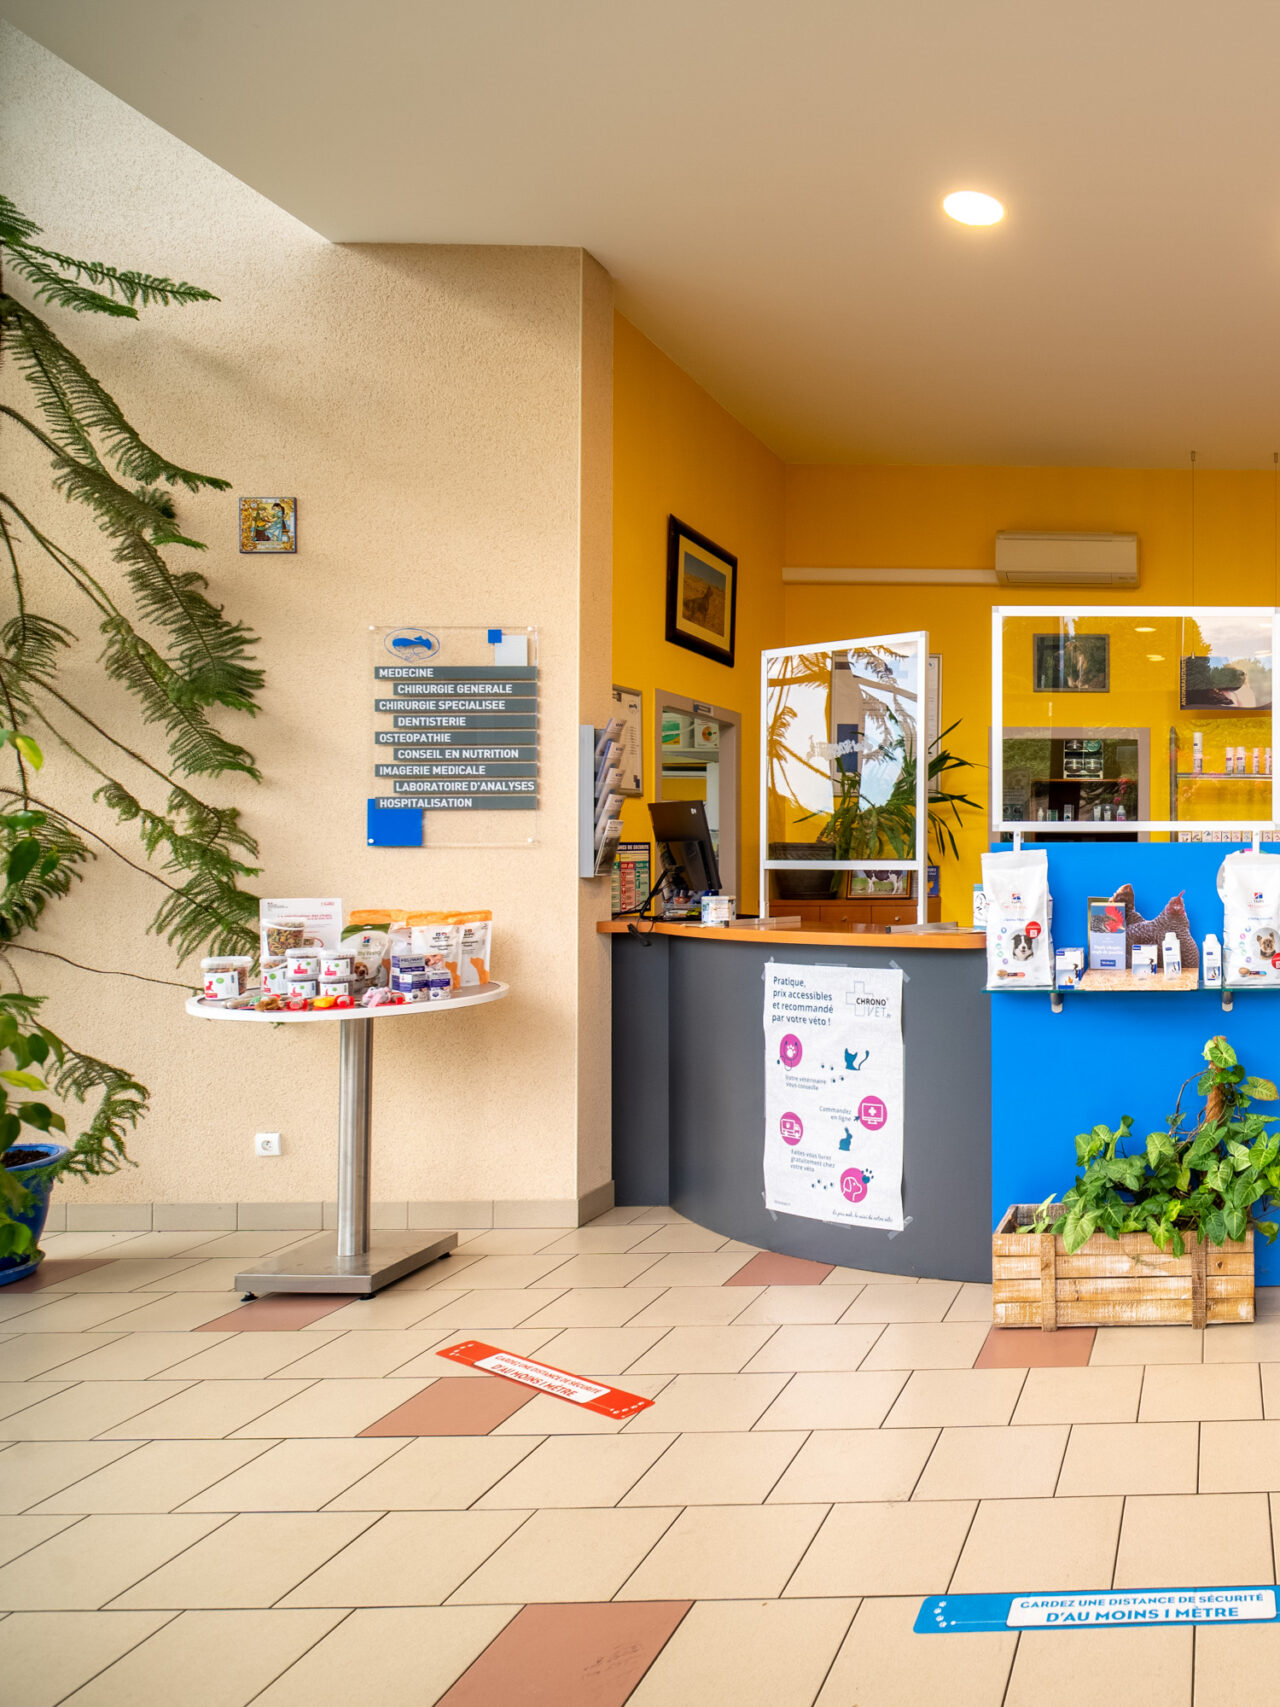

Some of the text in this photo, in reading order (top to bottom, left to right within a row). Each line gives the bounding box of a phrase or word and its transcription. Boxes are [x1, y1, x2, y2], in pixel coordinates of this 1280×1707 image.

[379, 669, 434, 677] MEDECINE
[398, 685, 512, 693] CHIRURGIE GENERALE
[379, 701, 505, 710] CHIRURGIE SPECIALISEE
[398, 717, 466, 726] DENTISTERIE
[379, 734, 451, 742] OSTEOPATHIE
[398, 750, 519, 759] CONSEIL EN NUTRITION
[379, 766, 485, 775] IMAGERIE MEDICALE
[396, 782, 534, 791] LABORATOIRE D'ANALYSES
[379, 799, 472, 807] HOSPITALISATION
[773, 976, 806, 988] Pratique,
[773, 990, 832, 1001] prix accessibles
[856, 997, 887, 1006] CHRONO
[773, 1002, 833, 1013] et recommandé
[772, 1014, 784, 1023] par
[786, 1015, 807, 1024] votre
[809, 1016, 826, 1026] véto
[1020, 1593, 1263, 1609] GARDEZ UNE DISTANCE DE SÉCURITÉ
[1046, 1611, 1090, 1623] D'AU
[1095, 1610, 1159, 1621] MOINS
[1175, 1606, 1239, 1618] MÈTRE
